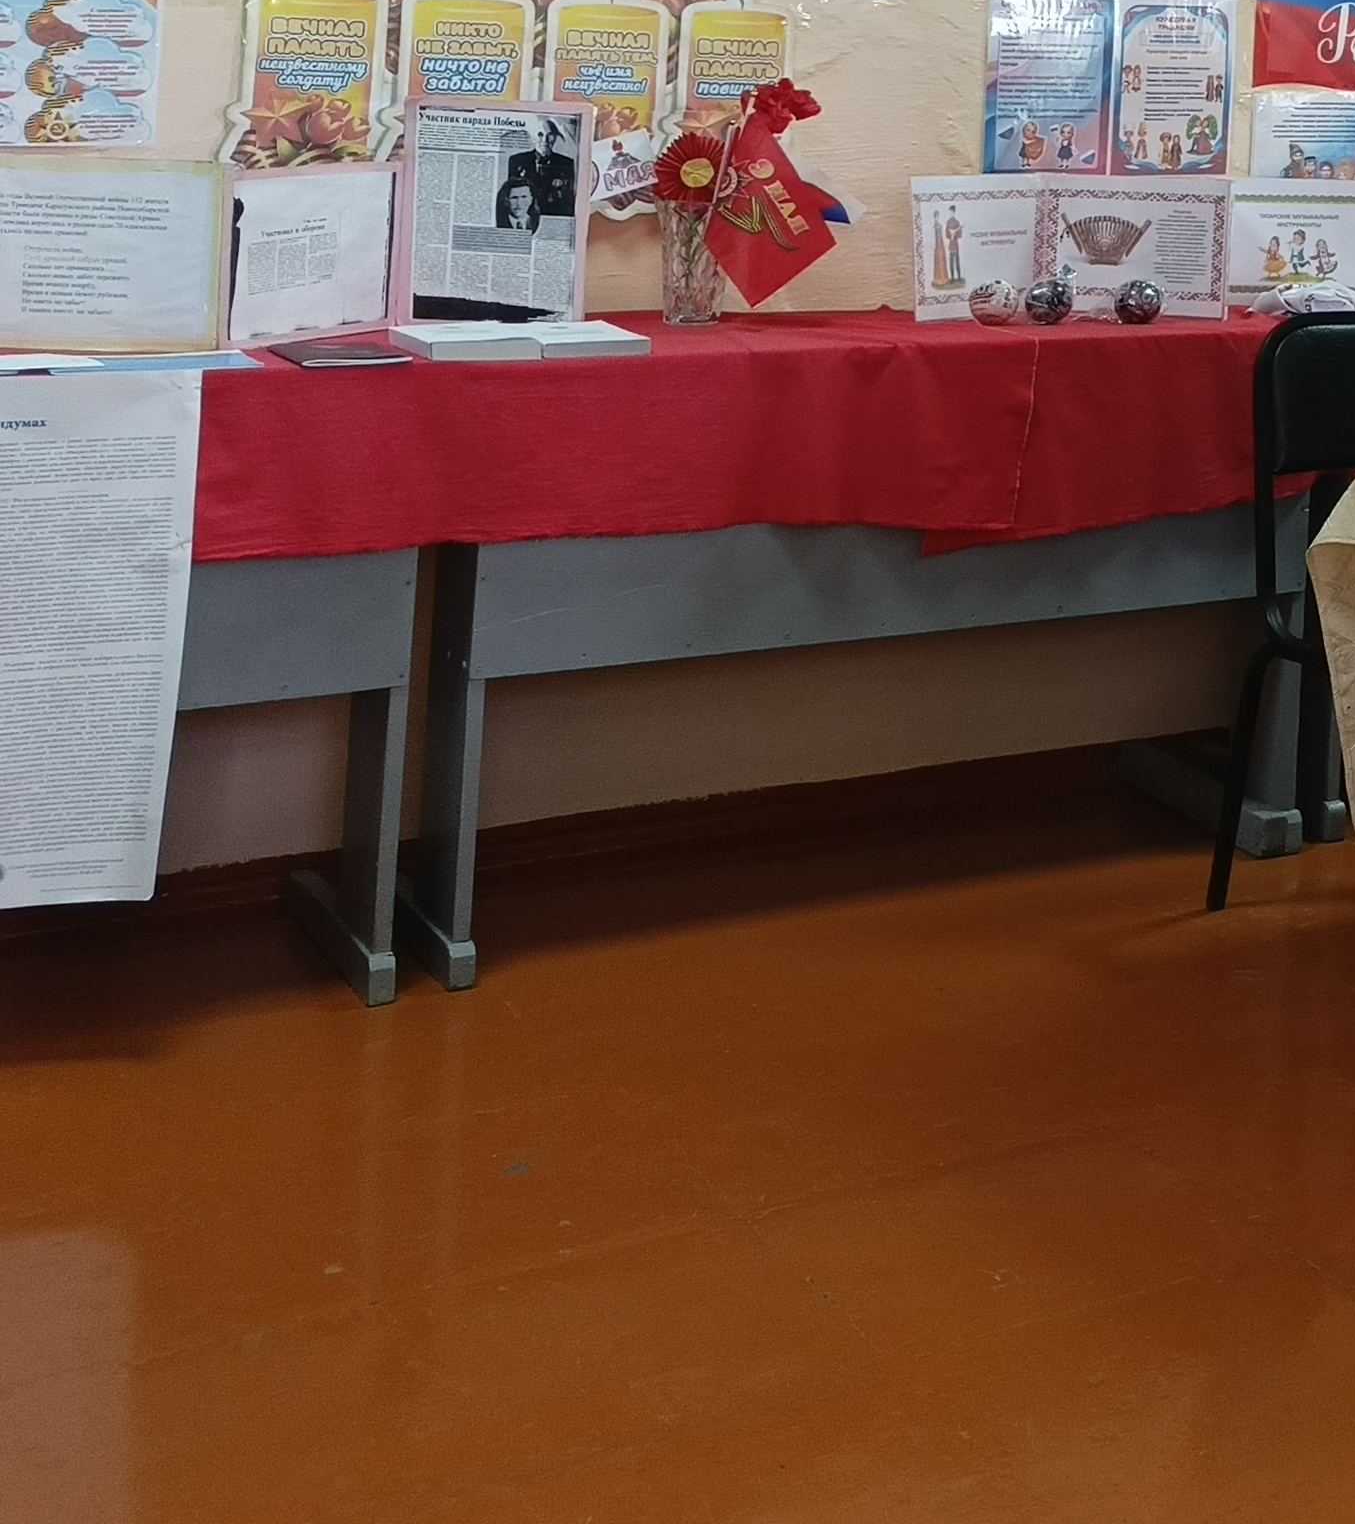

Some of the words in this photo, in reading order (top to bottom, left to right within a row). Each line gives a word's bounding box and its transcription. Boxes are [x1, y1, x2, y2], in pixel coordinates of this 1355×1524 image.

[270, 17, 365, 38] ВЕЧНАЯ
[436, 22, 503, 38] НИКТО
[266, 37, 365, 57] ПАМЯТЬ
[417, 39, 444, 55] НЕ
[566, 30, 650, 49] ВЕЧНАЯ
[697, 39, 780, 58] ВЕЧНАЯ
[556, 48, 620, 63] ПАМЯТЬ
[259, 59, 368, 78] неизвестному
[421, 59, 480, 76] ничто
[485, 60, 510, 74] не
[605, 65, 634, 78] имя
[693, 61, 780, 79] ПАМЯТЬ
[277, 73, 350, 92] солдату!
[425, 76, 505, 93] забыто!
[562, 78, 648, 98] неизвестно!
[418, 112, 460, 124] Участник
[464, 116, 492, 127] парада
[494, 116, 526, 127] Победы
[603, 160, 656, 192] МАЯ
[763, 180, 810, 236] МАЯ
